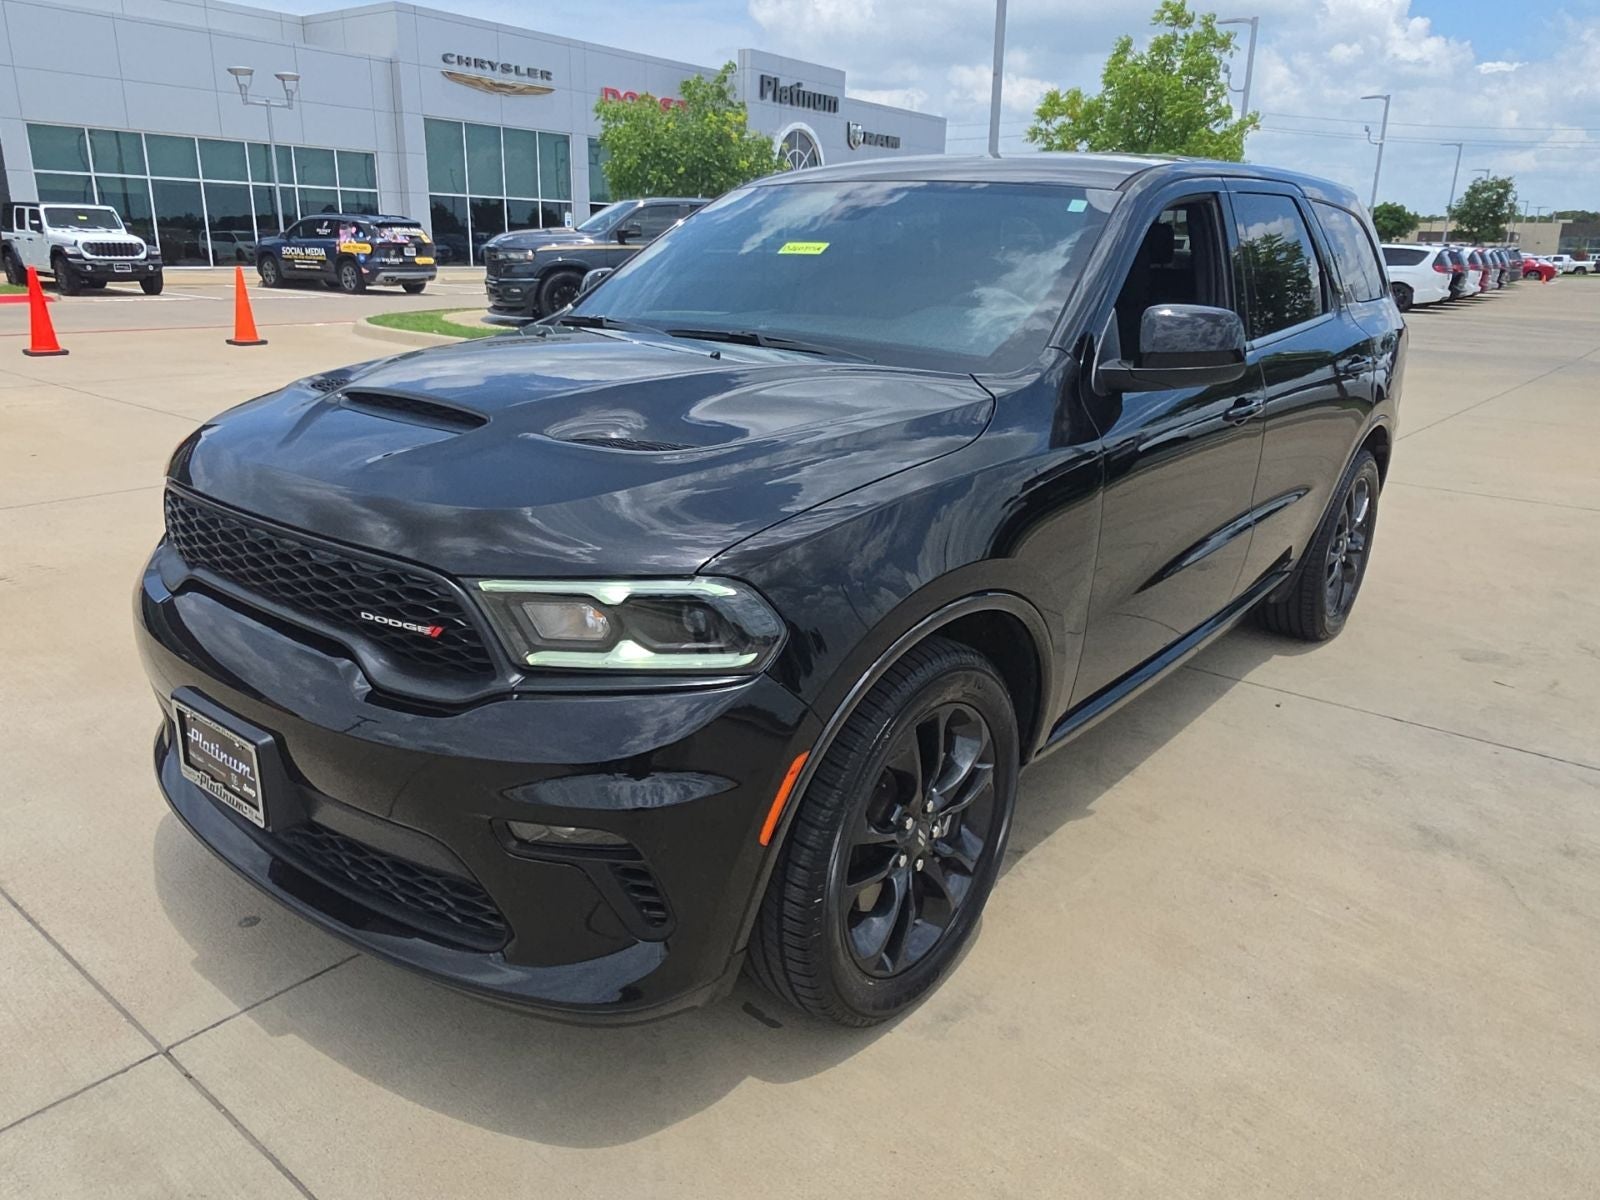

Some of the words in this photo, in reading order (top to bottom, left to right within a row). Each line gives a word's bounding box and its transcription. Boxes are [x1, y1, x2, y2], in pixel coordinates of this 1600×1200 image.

[441, 52, 553, 81] CHRYSLER
[759, 74, 839, 113] Platinum
[863, 131, 901, 149] RAM
[282, 246, 304, 256] SOCIAL
[304, 247, 326, 257] MEDIA
[360, 611, 432, 636] DODGE
[187, 727, 255, 781] Platinum
[200, 773, 248, 815] Platinum
